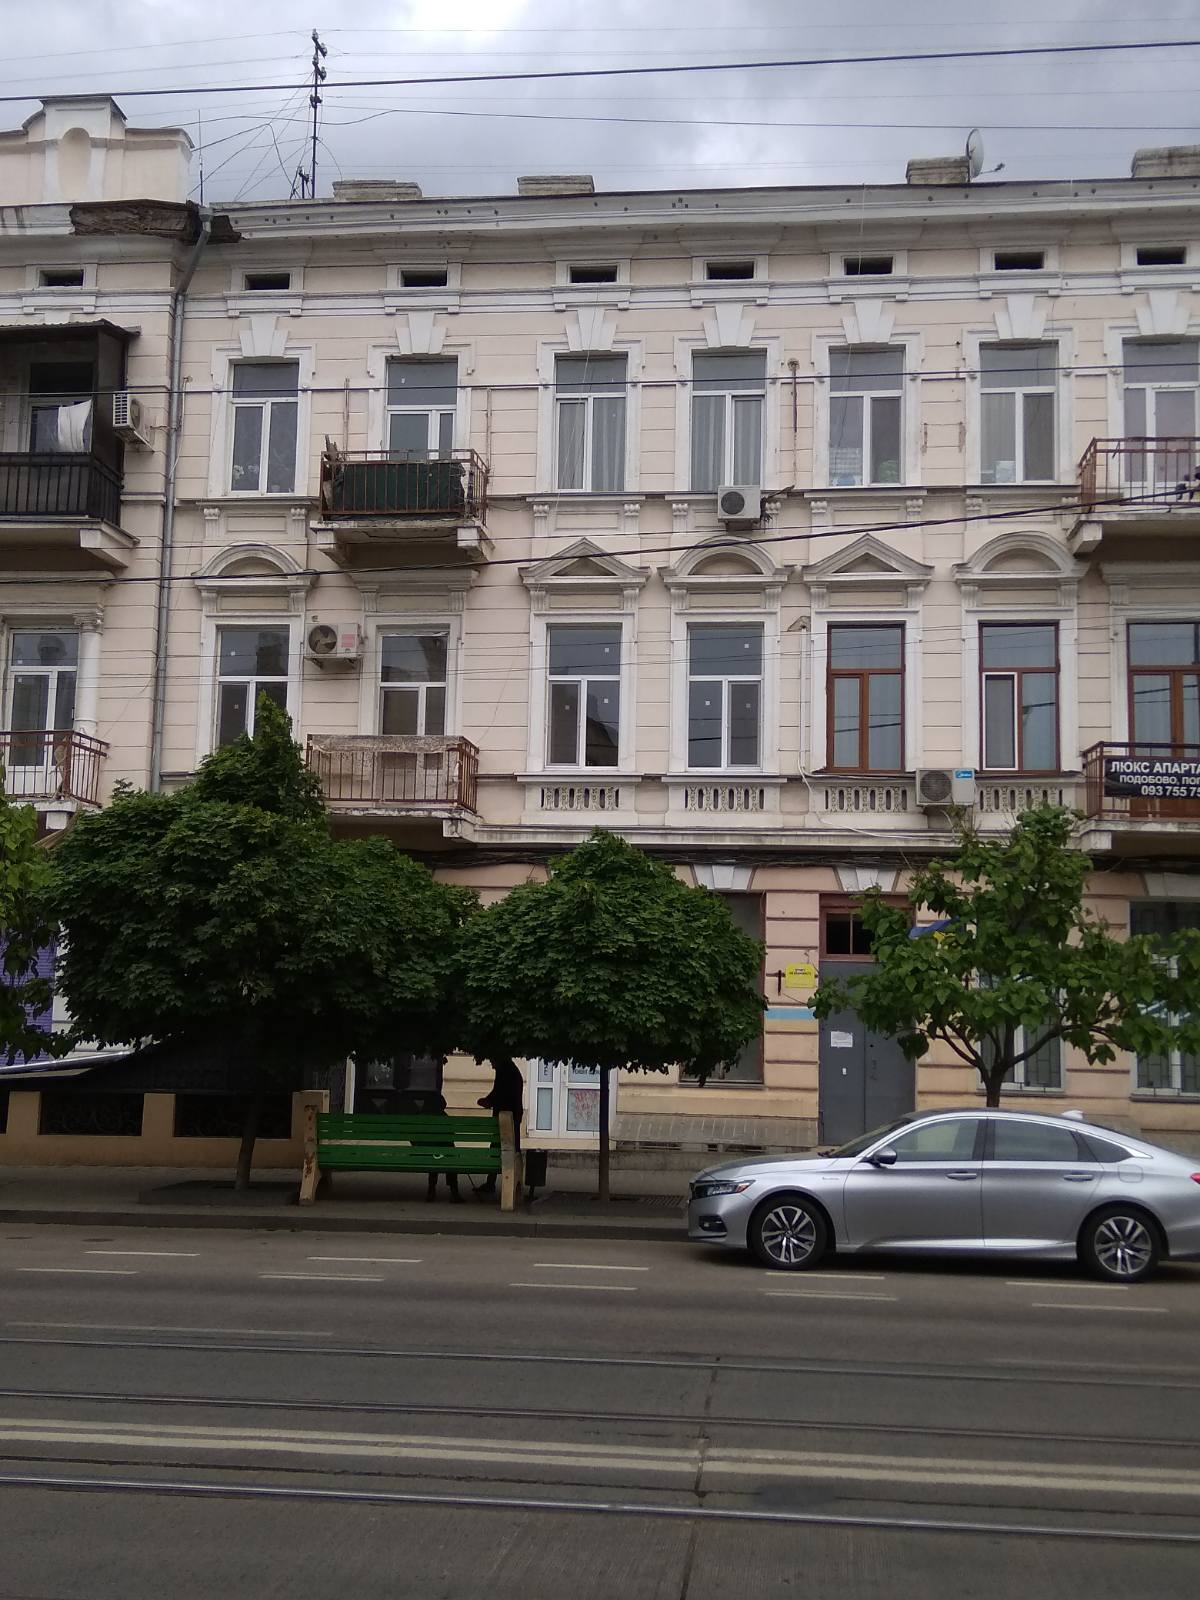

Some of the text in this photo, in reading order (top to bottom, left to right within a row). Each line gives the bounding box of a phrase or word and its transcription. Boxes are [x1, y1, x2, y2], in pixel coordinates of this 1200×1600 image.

[1111, 762, 1150, 773] ЛЮКС
[1141, 785, 1163, 796] 093
[1165, 786, 1187, 797] 755
